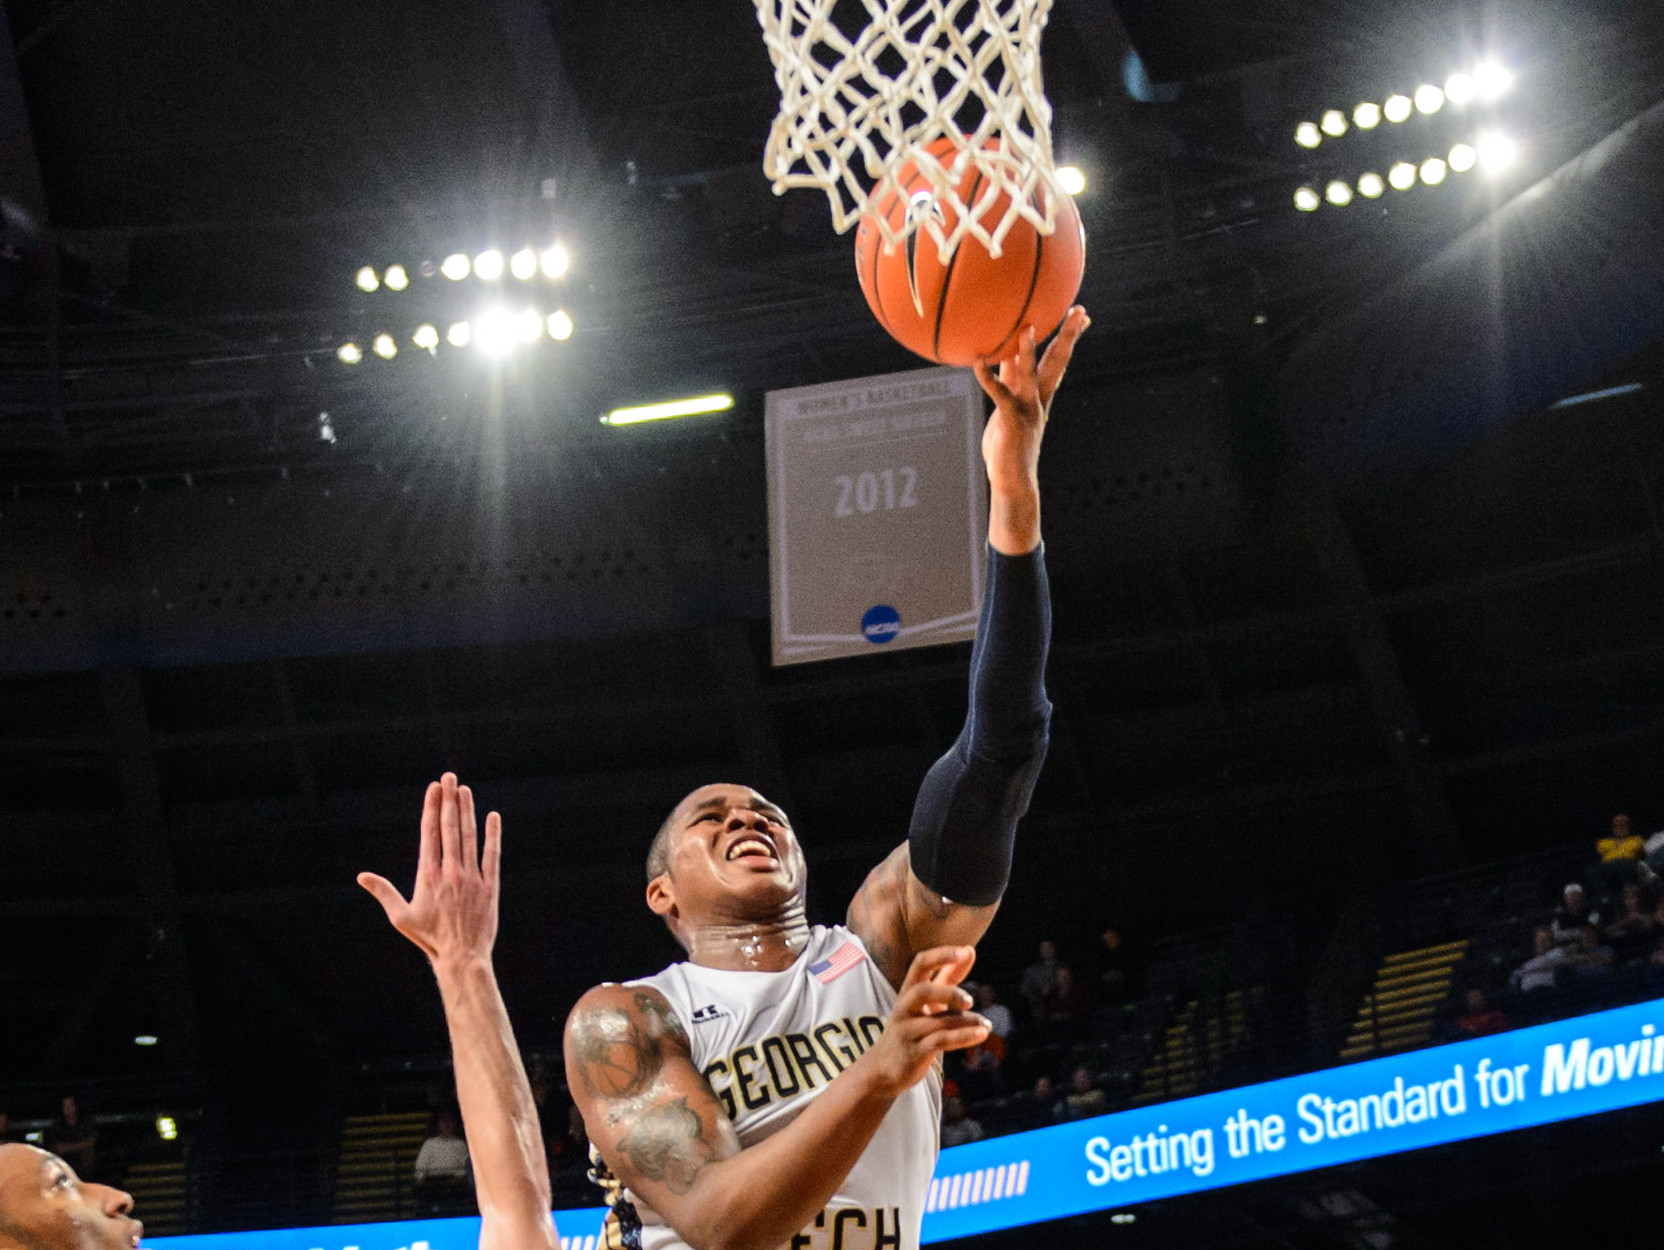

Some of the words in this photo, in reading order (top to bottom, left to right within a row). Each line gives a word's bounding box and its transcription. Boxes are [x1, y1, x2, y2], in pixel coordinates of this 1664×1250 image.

[833, 465, 918, 517] 2012
[1085, 1125, 1215, 1186] Setting
[1223, 1109, 1286, 1158] the
[1297, 1065, 1467, 1144] Standard
[1474, 1058, 1529, 1108] for
